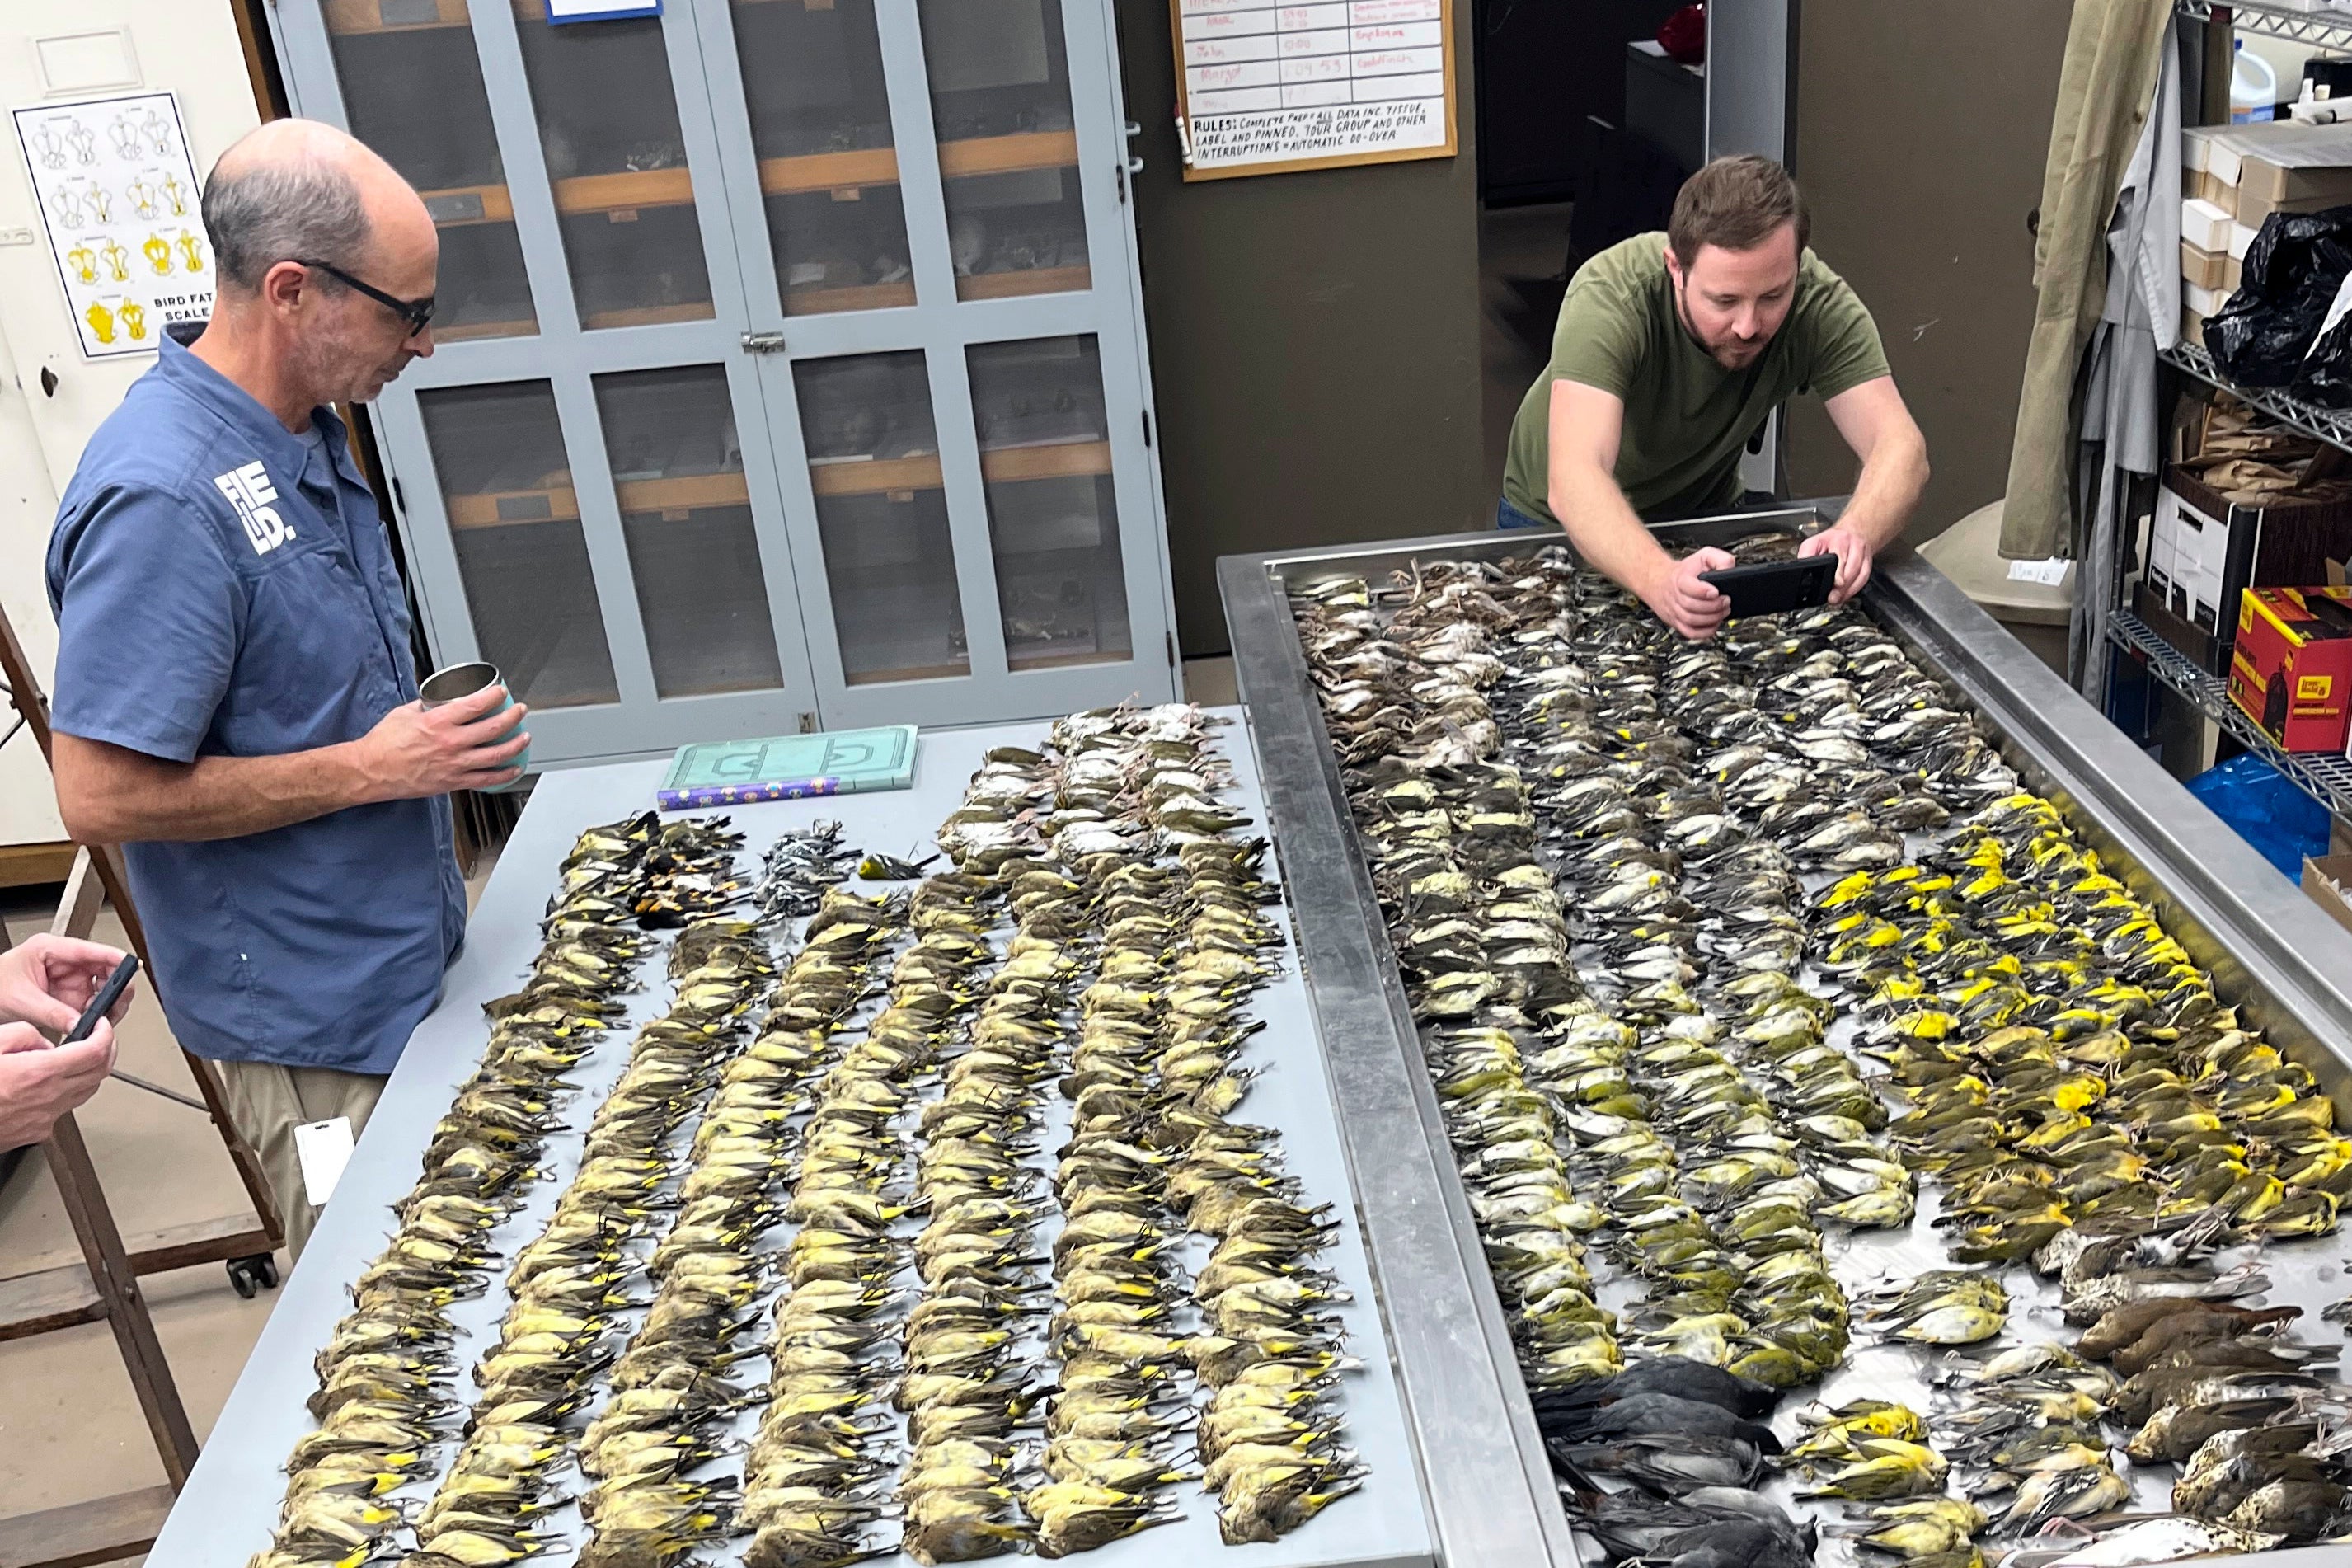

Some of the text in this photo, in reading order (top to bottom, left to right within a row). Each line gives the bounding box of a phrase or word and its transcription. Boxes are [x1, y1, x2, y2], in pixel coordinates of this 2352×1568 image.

[1195, 119, 1237, 133] RULES:
[1317, 110, 1332, 123] ALL
[1336, 108, 1360, 120] DATA
[1195, 115, 1426, 147] LABEL AND PINNED. TOUR GROUP AND OTHER
[1197, 141, 1279, 159] INTERRUPTIONS
[1289, 135, 1344, 151] AUTOMATIC
[155, 293, 213, 307] BIRD FAT
[165, 308, 210, 321] SCALE
